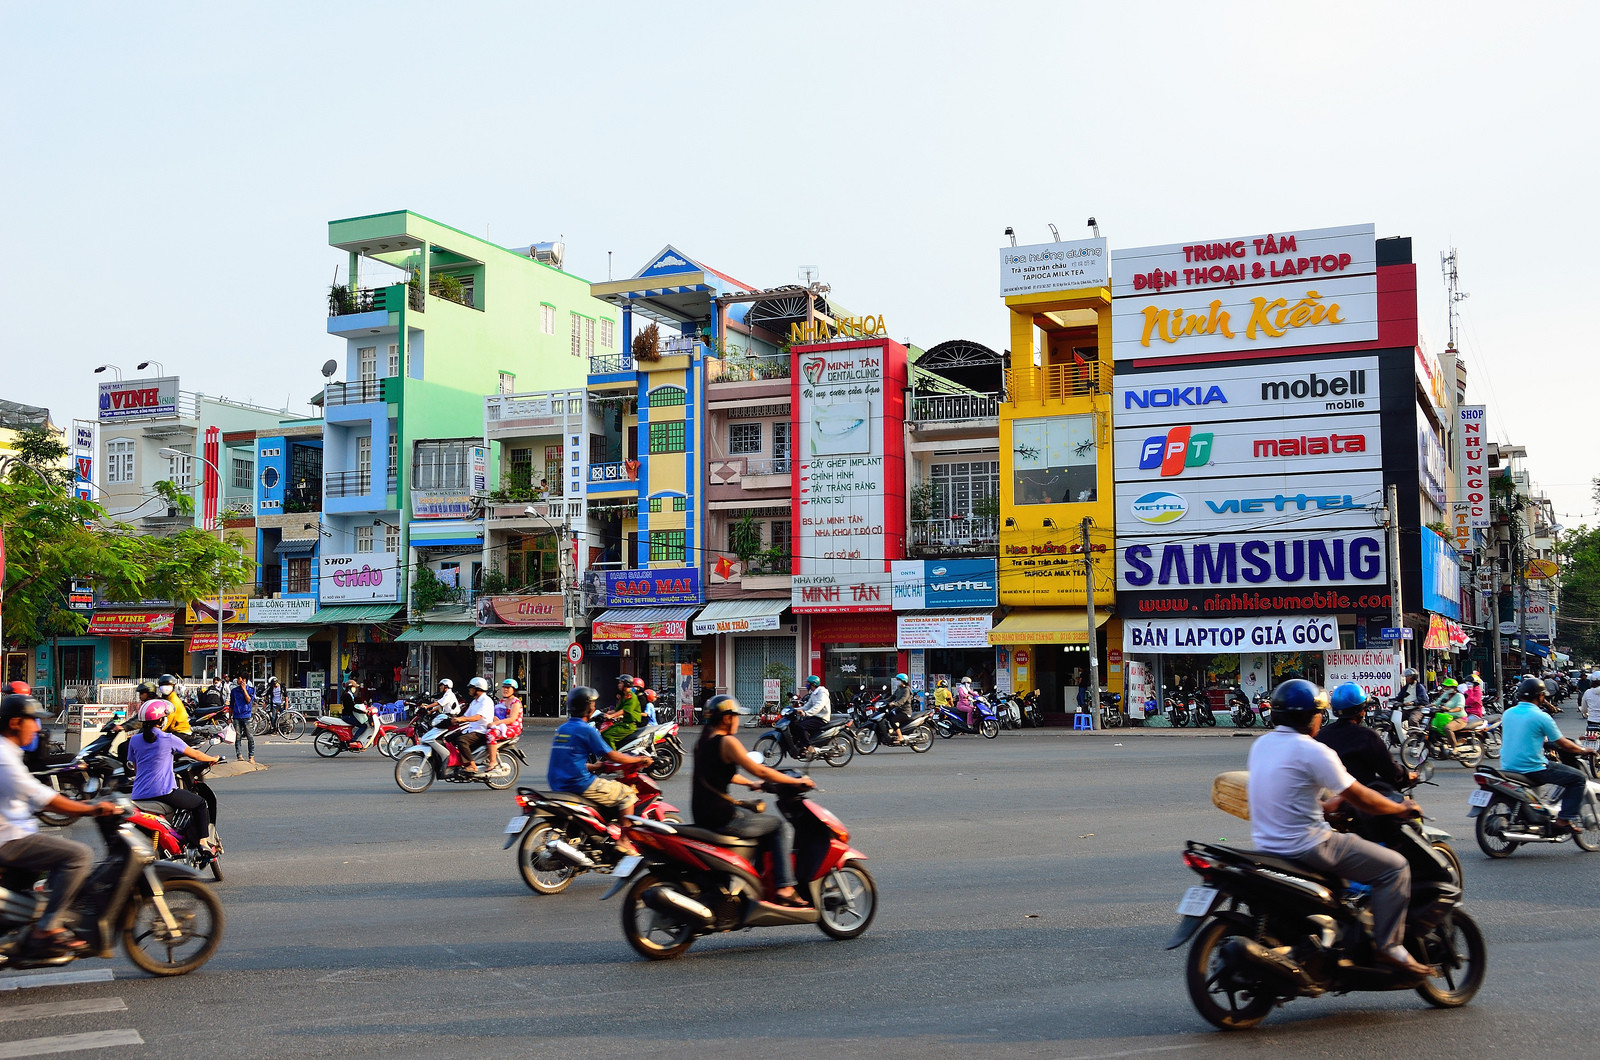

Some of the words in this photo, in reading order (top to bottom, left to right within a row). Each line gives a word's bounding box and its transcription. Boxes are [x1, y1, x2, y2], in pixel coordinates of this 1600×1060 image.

[1183, 241, 1245, 263] TRUNG
[1253, 234, 1297, 256] TÂM
[1005, 255, 1026, 264] Hoa
[1133, 268, 1177, 292] ĐIỆN
[1184, 263, 1245, 285] THOẠI
[1252, 262, 1265, 279] &
[1270, 253, 1351, 278] LAPTOP
[1140, 300, 1235, 347] Ninh
[1246, 290, 1346, 340] Kiều
[791, 320, 830, 342] NHA
[837, 314, 887, 337] KHOA
[828, 361, 854, 370] MINH
[859, 358, 879, 368] TÂN
[828, 370, 855, 381] DENTAL
[856, 369, 880, 379] CLINIC
[1262, 369, 1365, 400] mobell
[110, 388, 159, 409] VINH
[1124, 385, 1228, 409] NOKIA
[1325, 399, 1364, 410] mobile
[1461, 410, 1483, 419] SHOP
[78, 429, 91, 438] Nhà
[78, 438, 91, 448] May
[1254, 434, 1365, 457] malata
[850, 458, 882, 466] IMPLANT
[1134, 503, 1185, 511] VIETTEL
[1205, 494, 1366, 514] VIETTEL
[1456, 514, 1470, 549] THY
[1006, 545, 1028, 554] Hoa
[1124, 537, 1380, 586] SAMSUNG
[333, 564, 382, 587] CHÂU
[628, 571, 652, 579] SALON
[616, 580, 650, 596] SAO
[655, 578, 691, 594] MAI
[802, 586, 840, 602] MINH
[850, 583, 880, 601] TÂN
[930, 581, 992, 591] VIETTEL
[287, 599, 310, 608] THÀNH
[518, 603, 553, 615] Châu
[665, 622, 683, 634] 30%
[1132, 622, 1168, 646] BÁN
[1176, 628, 1245, 646] LAPTOP
[1252, 620, 1286, 645] GIÁ
[1293, 619, 1333, 644] GỐC
[1328, 652, 1341, 667] ĐIỆN
[1343, 654, 1360, 667] THOẠI
[1362, 650, 1372, 665] KẾT
[1374, 650, 1385, 665] NỐI
[1352, 672, 1391, 681] 1,599.000
